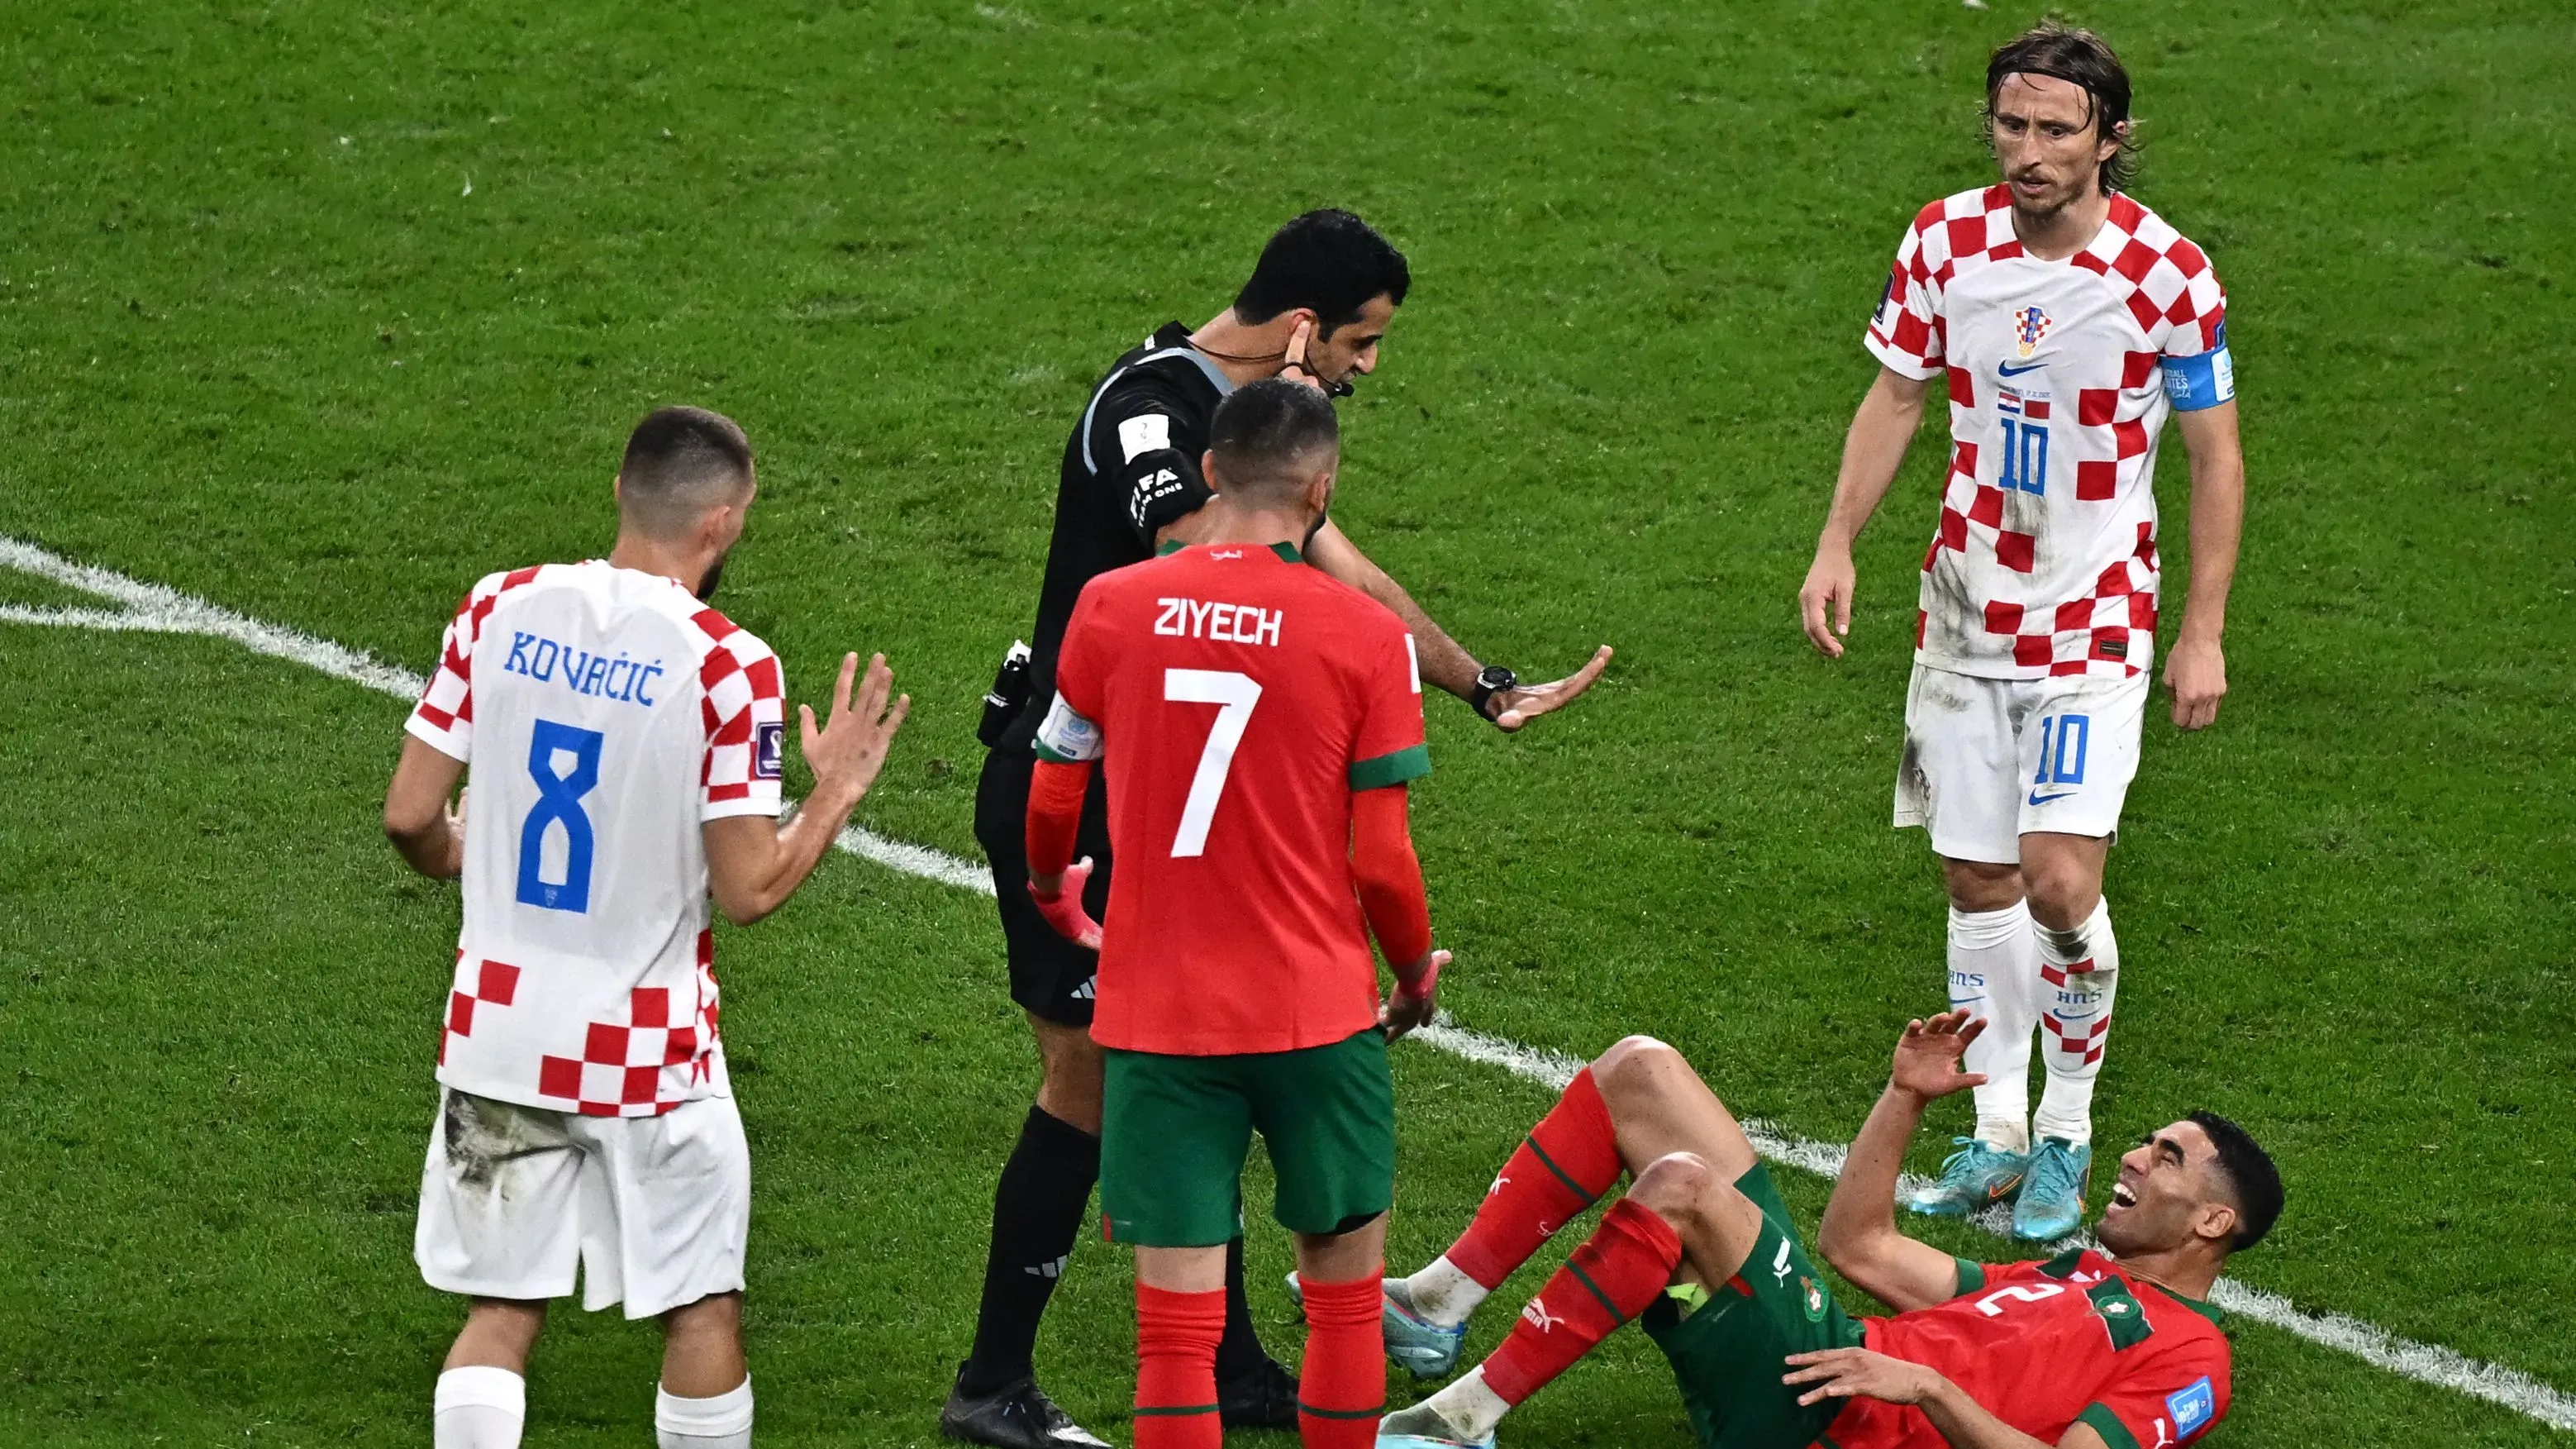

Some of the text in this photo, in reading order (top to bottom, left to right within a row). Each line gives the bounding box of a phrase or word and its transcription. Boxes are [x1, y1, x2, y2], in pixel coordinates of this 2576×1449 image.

[1155, 482, 1183, 498] ONE
[1998, 417, 2049, 496] 10
[1155, 598, 1283, 646] ZIYECH
[1164, 668, 1263, 858] 7
[2035, 714, 2089, 784] 10
[516, 718, 604, 914] 8
[1974, 1284, 2064, 1317] 2
